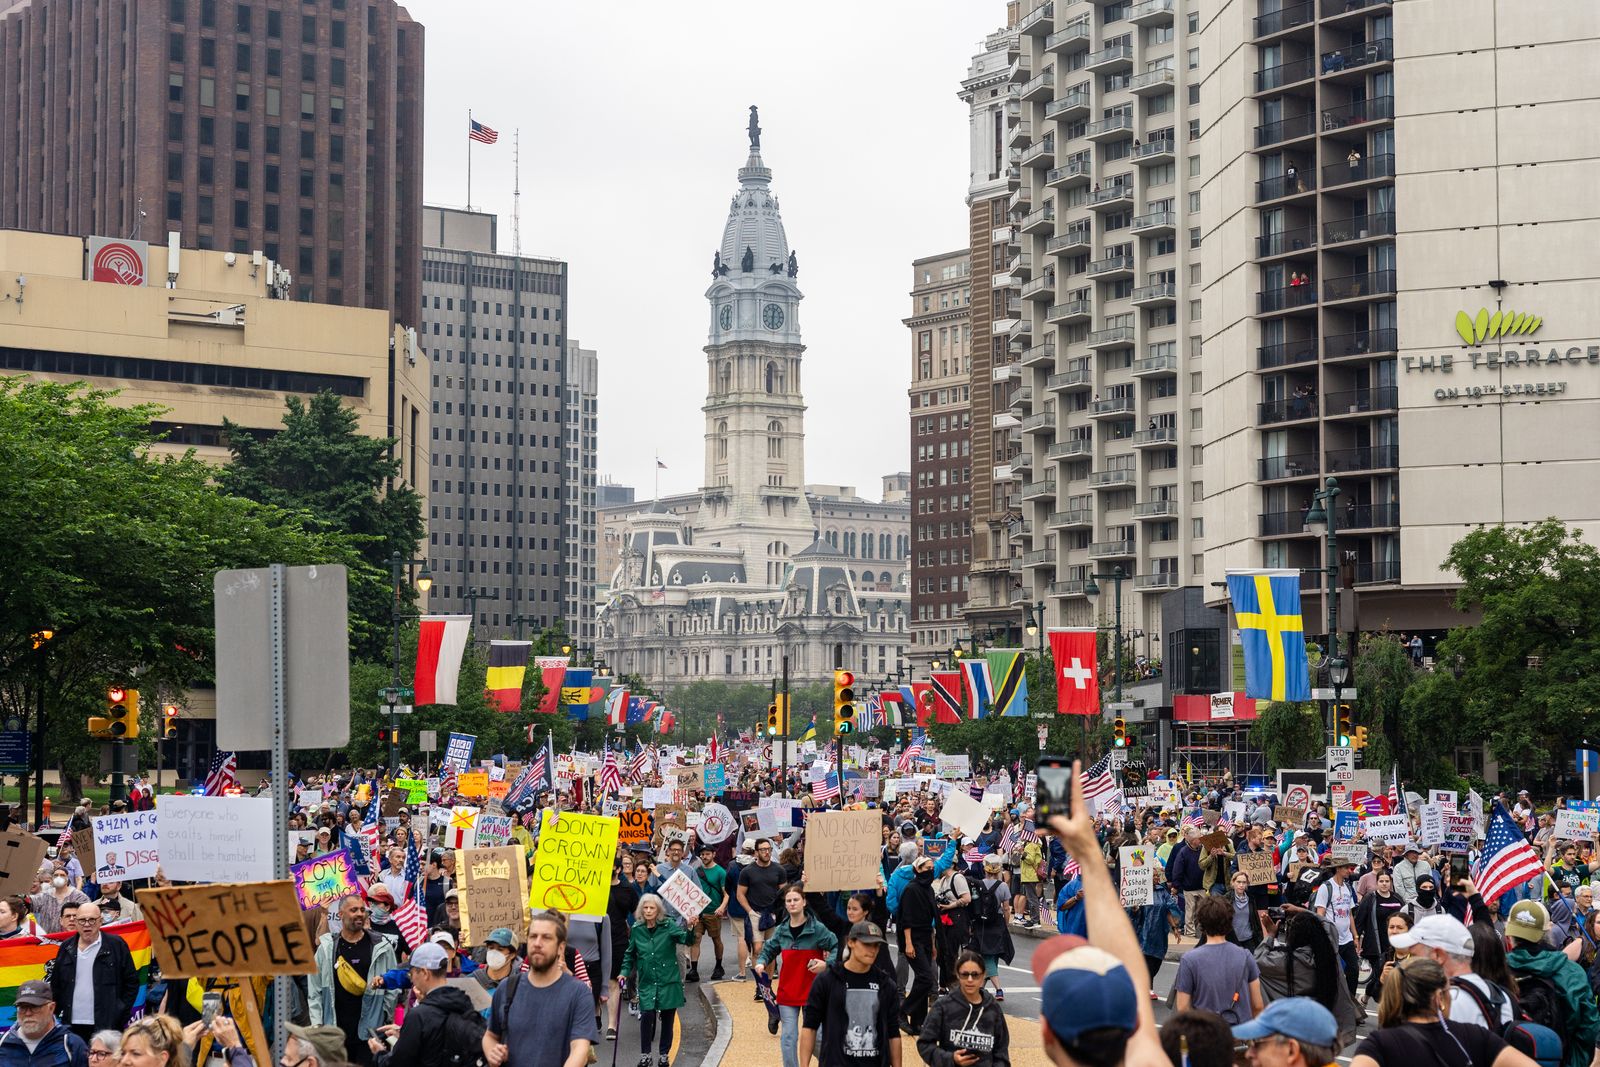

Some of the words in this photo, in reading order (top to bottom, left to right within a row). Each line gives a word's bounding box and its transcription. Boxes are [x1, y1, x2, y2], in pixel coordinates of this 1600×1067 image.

[1401, 354, 1453, 374] THE
[1468, 346, 1600, 370] TERRACE
[1434, 388, 1458, 401] ON
[1502, 382, 1567, 398] STREET
[1330, 749, 1350, 757] STOP
[164, 800, 215, 824] Everyone
[218, 806, 239, 820] who
[620, 812, 642, 827] NO
[96, 818, 129, 831] $42M
[134, 813, 146, 826] of
[555, 818, 610, 838] DON'T
[98, 834, 124, 845] WASTE
[132, 830, 146, 840] ON
[201, 846, 215, 860] be
[543, 838, 610, 860] CROWN
[126, 850, 160, 868] DISG
[565, 858, 588, 869] THE
[98, 868, 126, 878] CLOWN
[300, 854, 352, 888] LOVE
[474, 868, 490, 876] TAKE
[491, 868, 508, 876] NOTE
[540, 864, 602, 886] CLOWN
[1121, 866, 1150, 876] Terrorist
[1252, 872, 1273, 882] AWAY
[316, 880, 332, 892] THY
[1122, 876, 1147, 886] Asshole
[468, 885, 503, 896] Bowing
[682, 882, 700, 900] NO
[1120, 888, 1148, 897] Causing
[498, 900, 516, 910] king
[664, 885, 696, 918] KINGS
[140, 889, 196, 941] WE
[208, 892, 279, 916] THE
[490, 912, 508, 921] cost
[166, 922, 310, 972] PEOPLE
